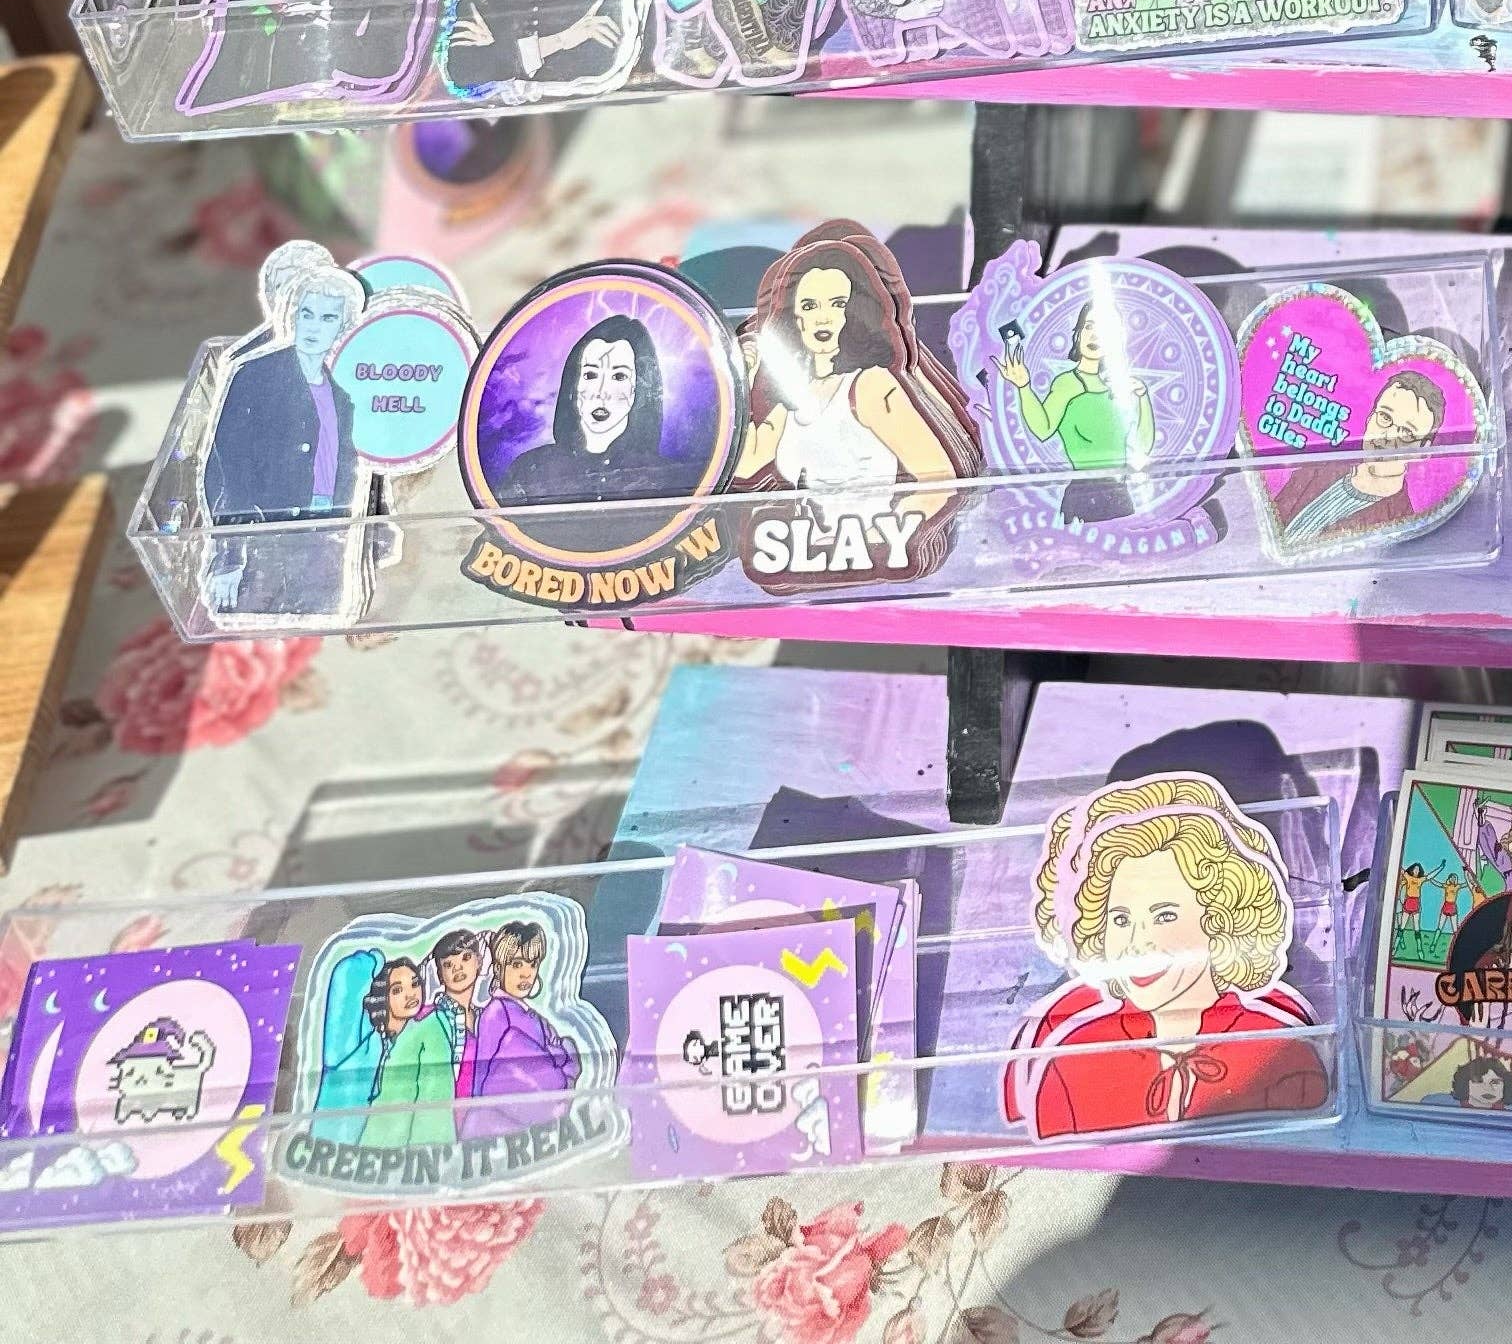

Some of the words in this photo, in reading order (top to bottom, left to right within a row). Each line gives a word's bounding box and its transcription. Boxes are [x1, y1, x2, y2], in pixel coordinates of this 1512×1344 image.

[1088, 5, 1200, 38] ANXIETY
[1204, 2, 1230, 28] IS
[1233, 0, 1253, 25] A
[355, 364, 443, 381] BLOODY
[1281, 353, 1339, 393] heart
[1288, 332, 1322, 364] My
[371, 396, 426, 412] HELL
[1265, 395, 1286, 416] to
[1288, 402, 1350, 447] Daddy
[1272, 372, 1352, 423] belongs
[1257, 414, 1307, 449] Giles
[752, 513, 924, 574] SLAY
[469, 540, 586, 603] BORED
[589, 556, 677, 604] NOW
[720, 995, 752, 1115] GAME
[751, 993, 786, 1115] OVER
[286, 1132, 453, 1185] CREEPIN'
[459, 1141, 500, 1180] IT
[502, 1099, 608, 1171] REAL
